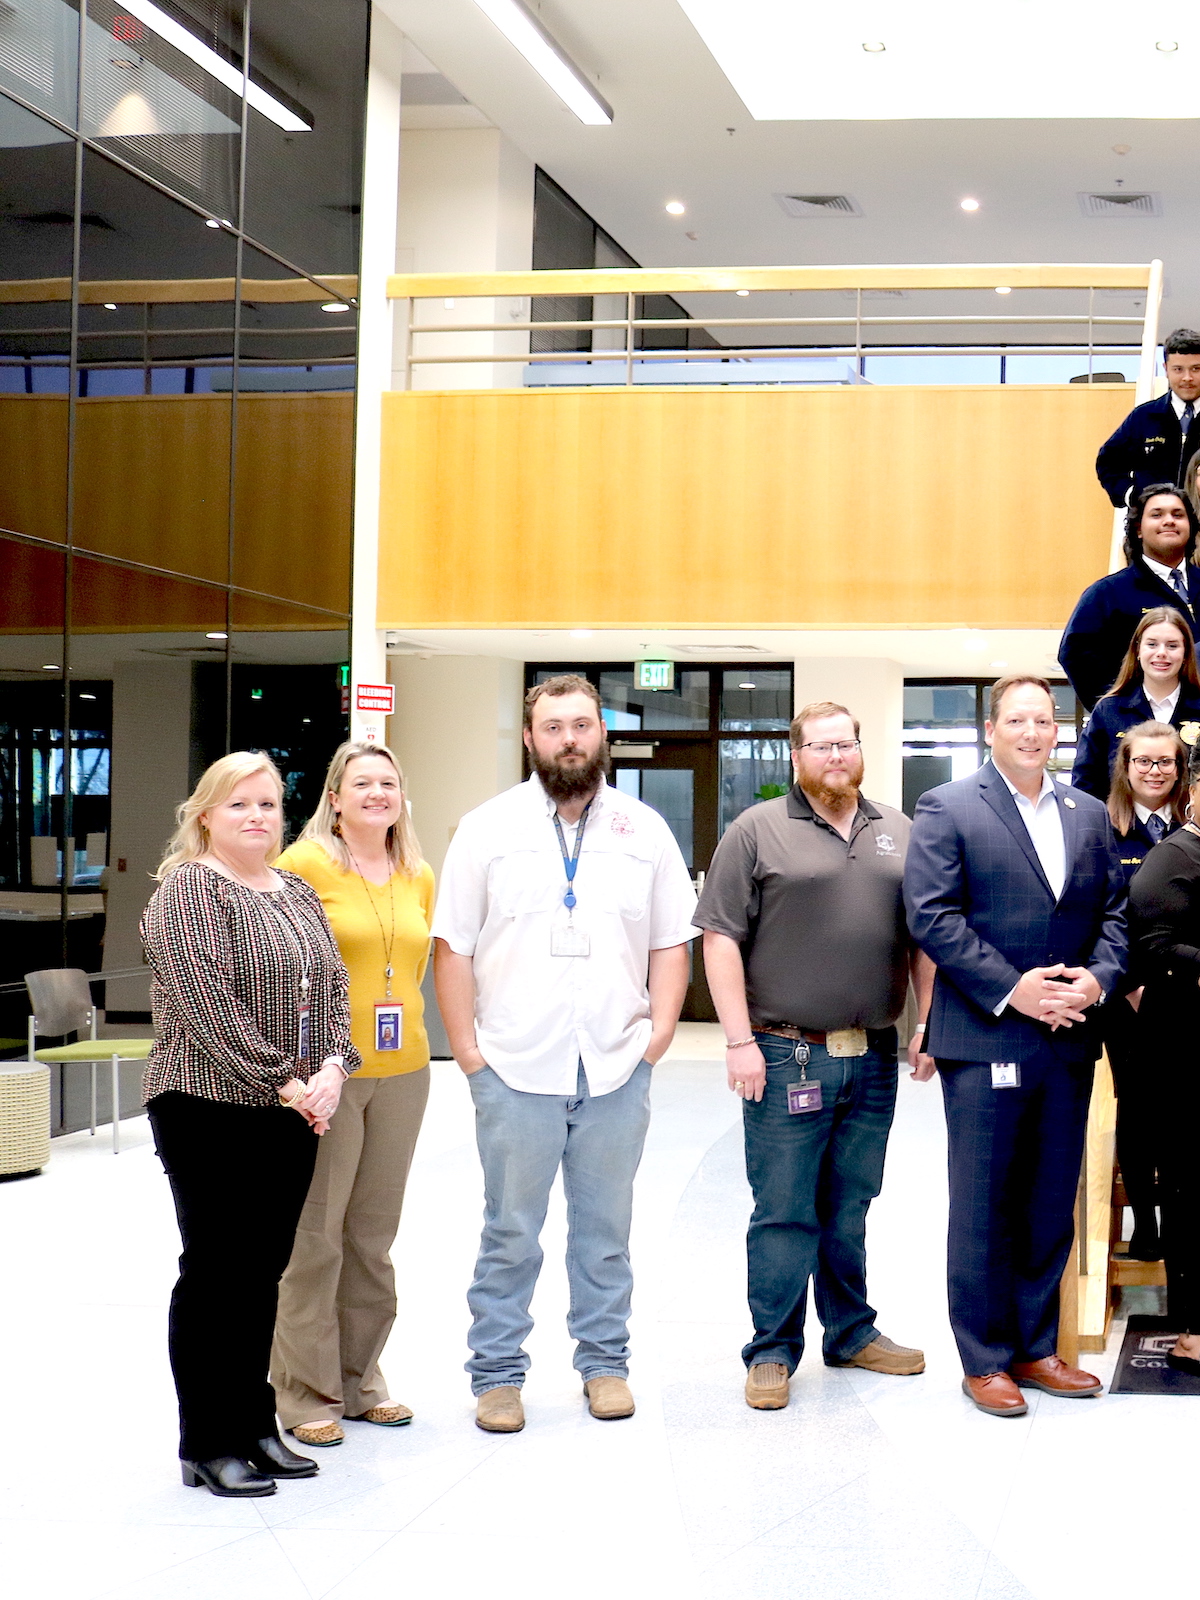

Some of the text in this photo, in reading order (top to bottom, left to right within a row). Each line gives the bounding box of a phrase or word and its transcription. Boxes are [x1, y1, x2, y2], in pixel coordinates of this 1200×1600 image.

[640, 662, 670, 687] EXIT
[358, 687, 392, 698] BLEEDING
[358, 698, 392, 710] CONTROL
